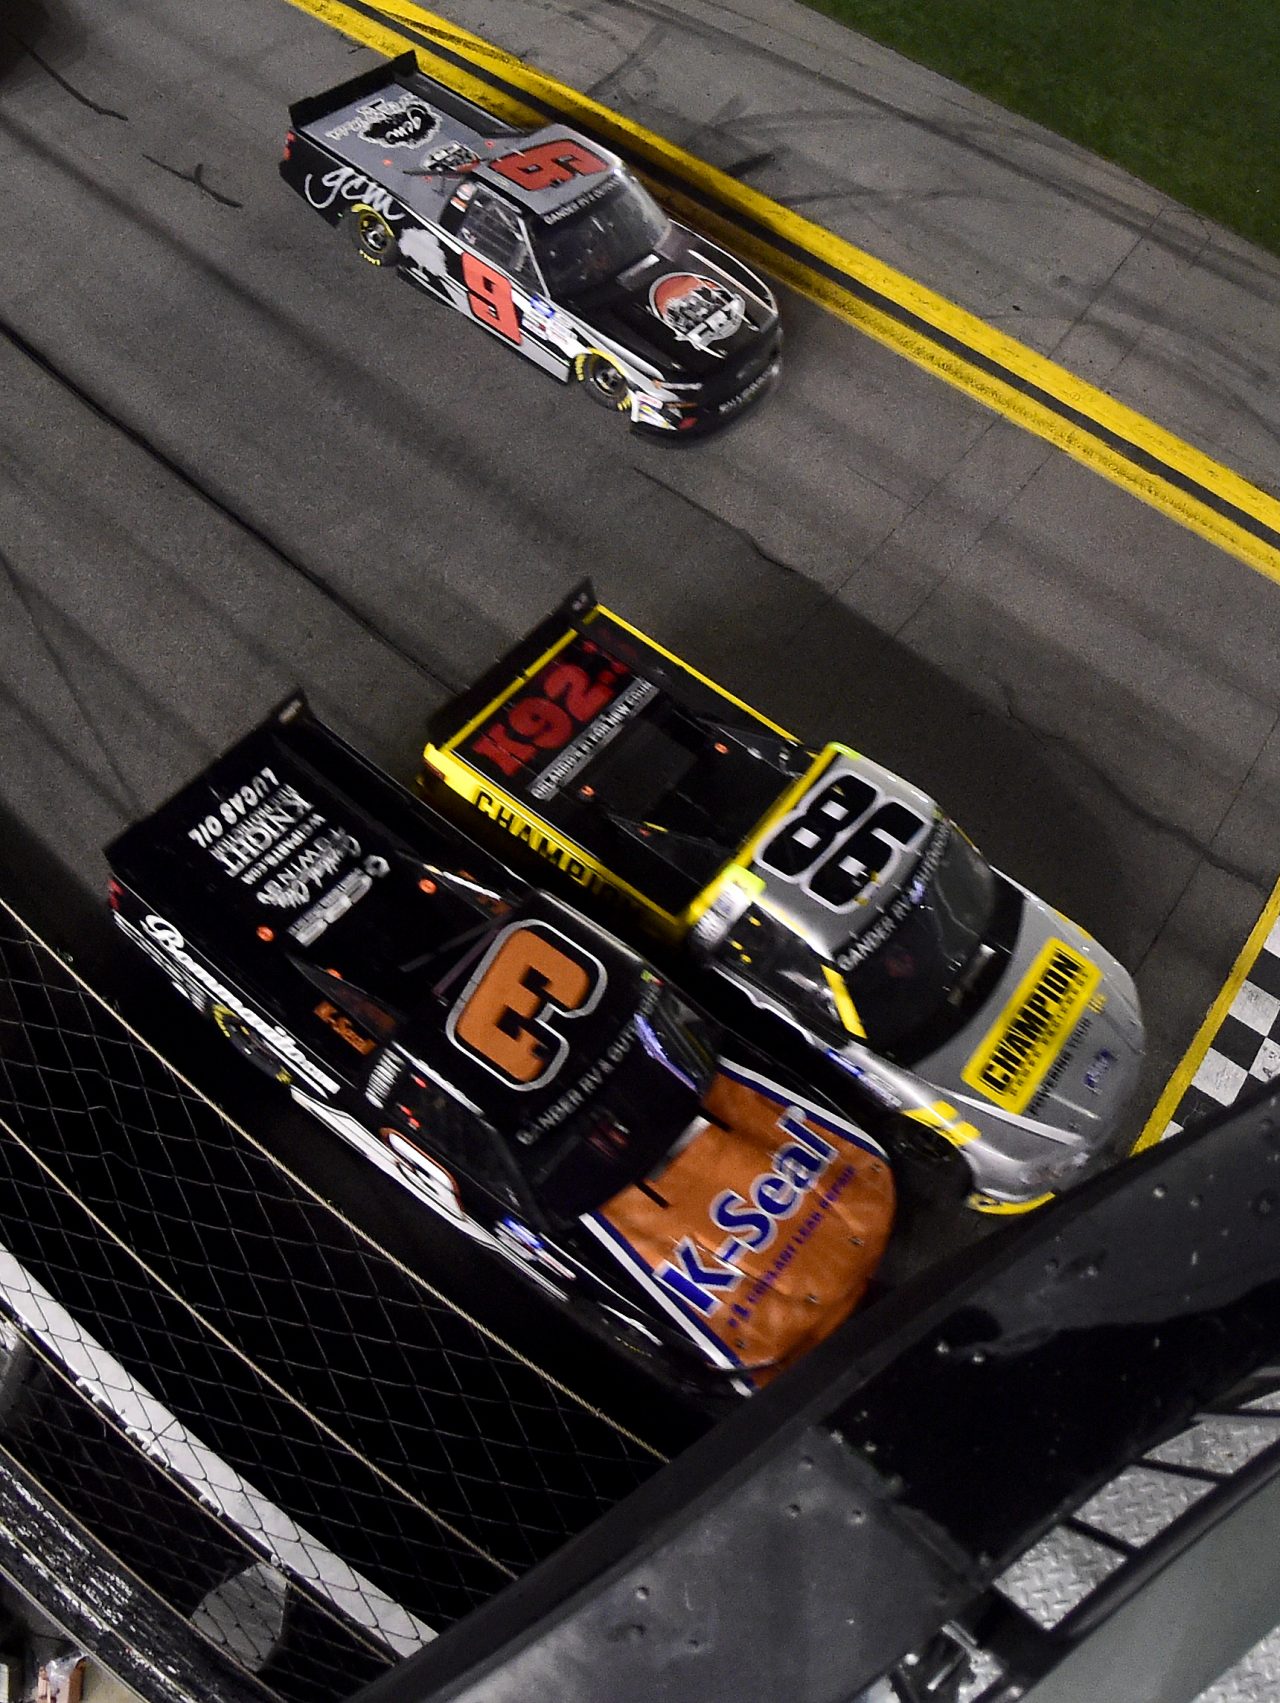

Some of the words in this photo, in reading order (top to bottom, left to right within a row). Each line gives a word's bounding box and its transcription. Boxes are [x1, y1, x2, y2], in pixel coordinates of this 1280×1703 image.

[490, 139, 608, 191] 9
[462, 252, 523, 345] 9
[186, 813, 224, 849] OIL
[218, 765, 279, 826] LUCAS
[450, 922, 604, 1088] 3
[975, 949, 1085, 1093] CHAMPION
[654, 1108, 840, 1318] K-Seal
